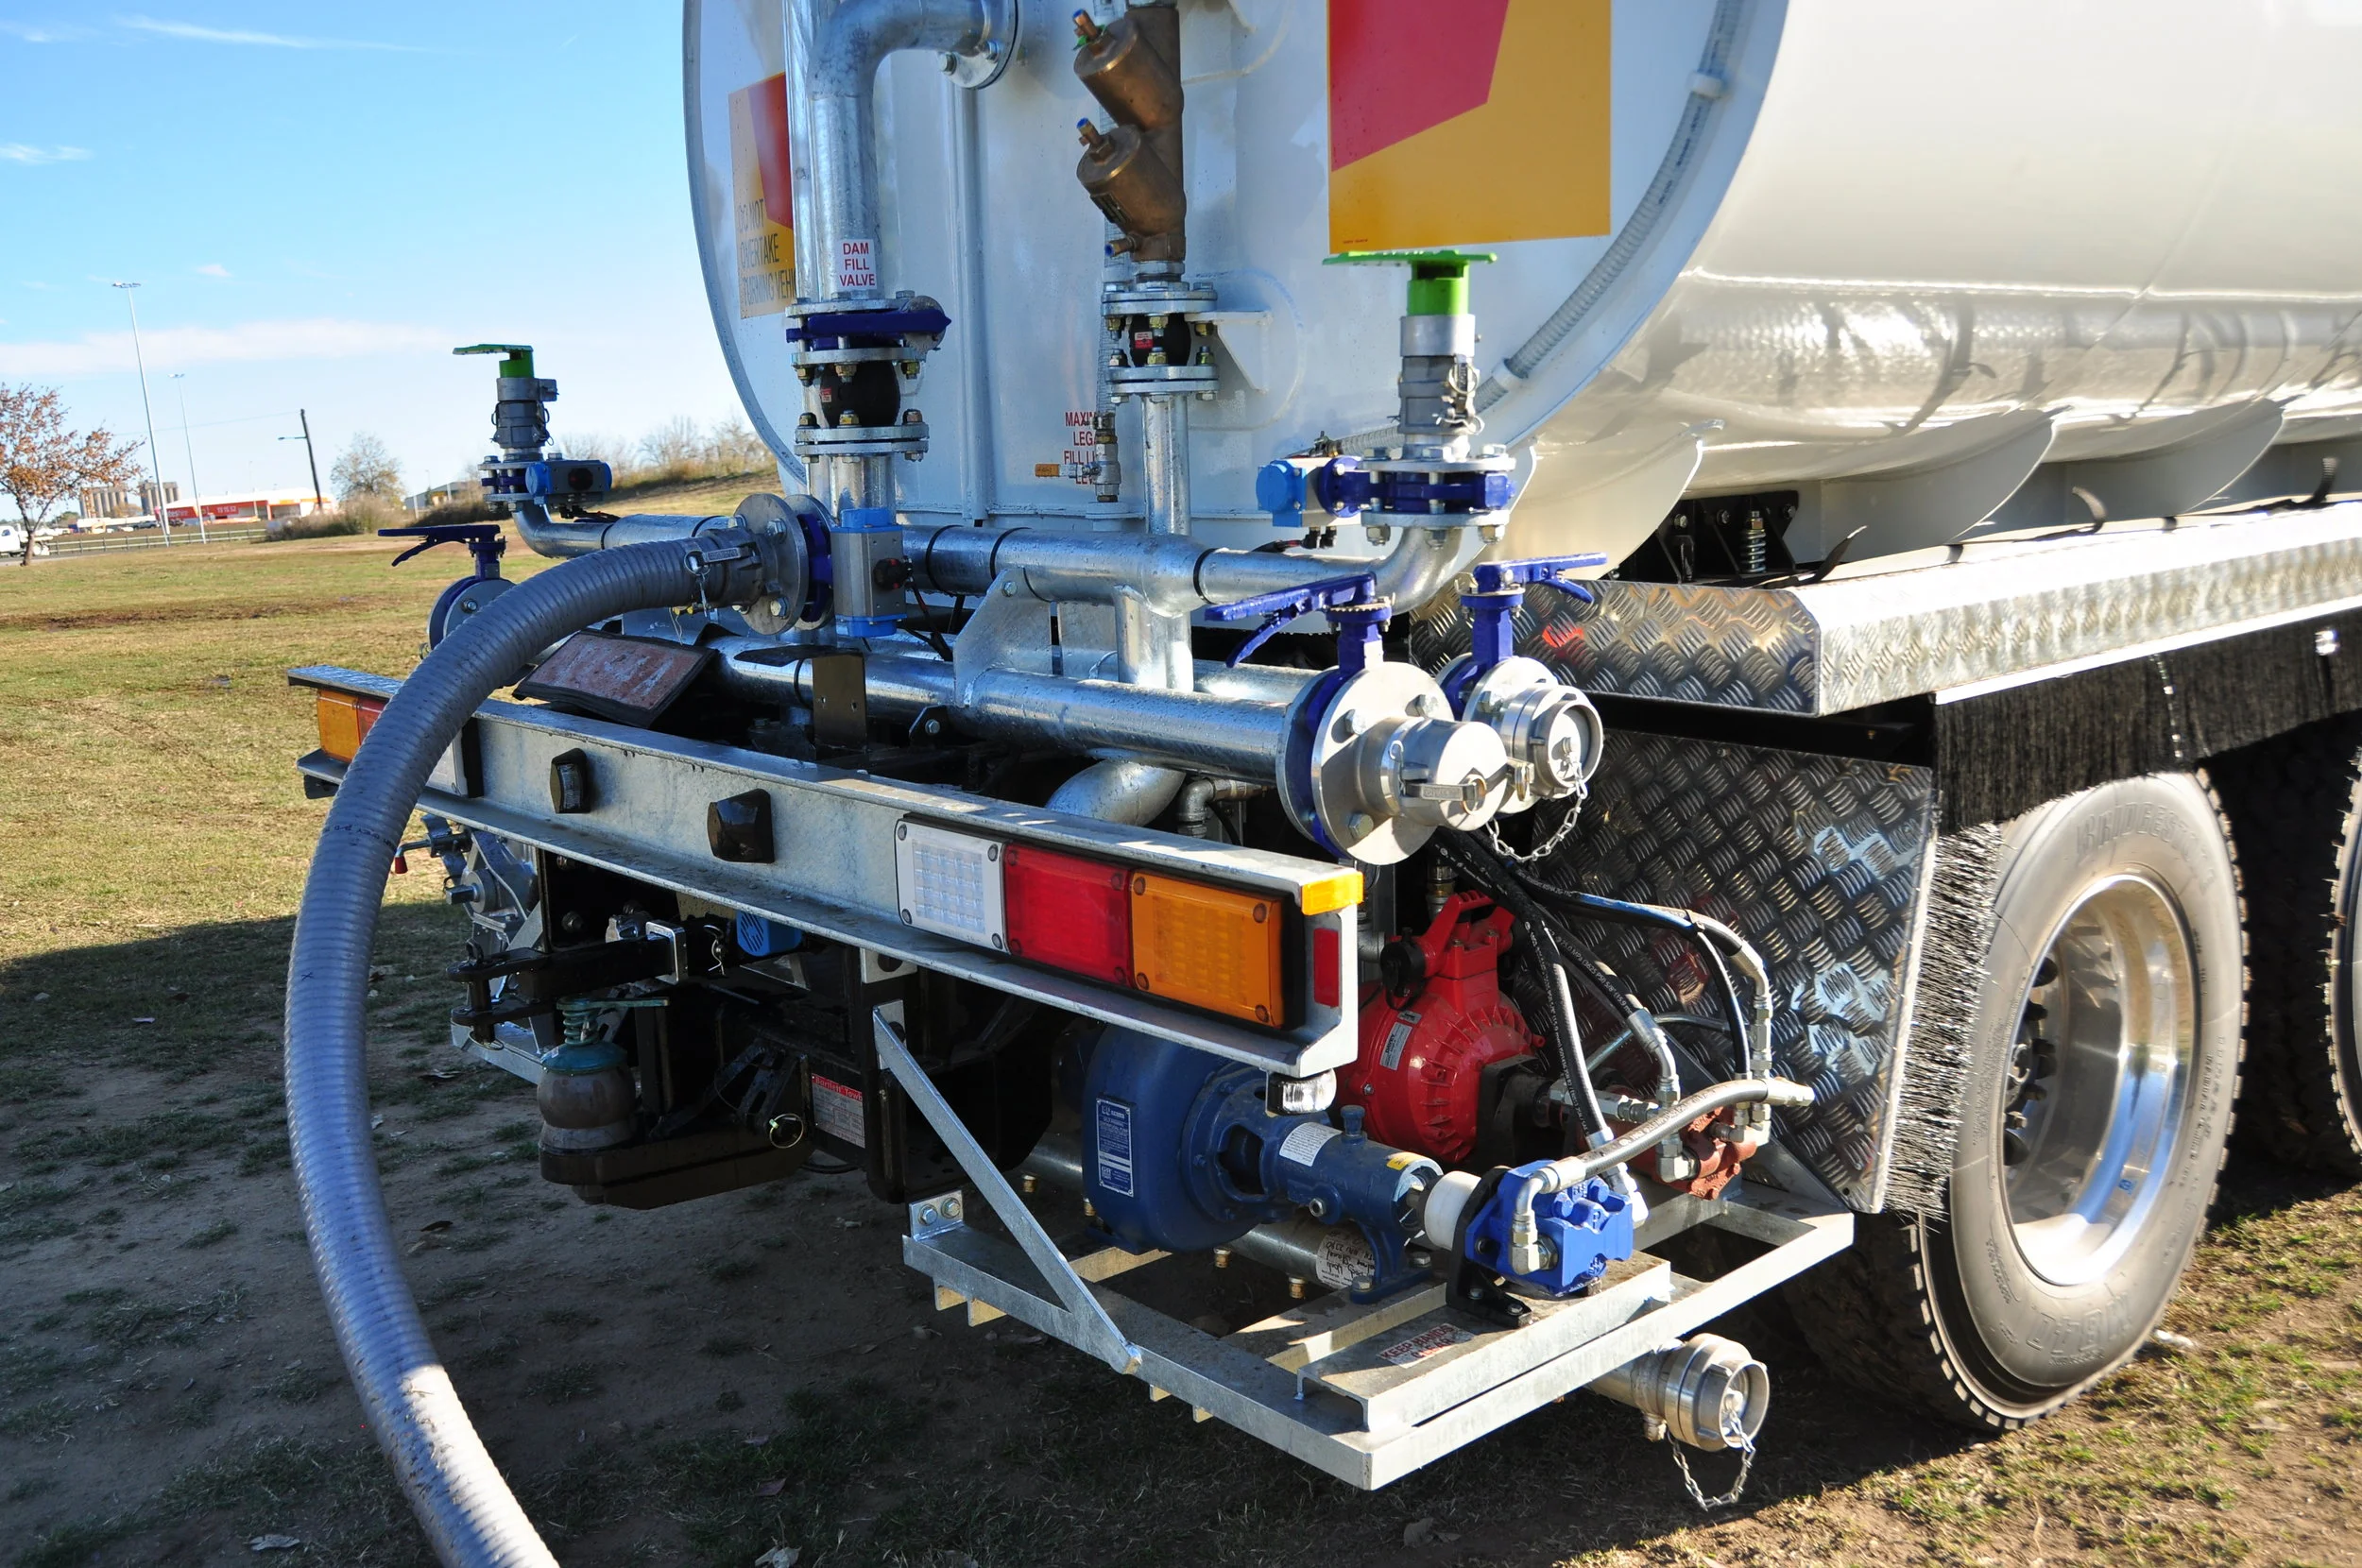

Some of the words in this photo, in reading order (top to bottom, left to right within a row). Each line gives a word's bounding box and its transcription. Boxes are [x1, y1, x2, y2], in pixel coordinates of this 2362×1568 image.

[749, 198, 764, 229] NOT
[740, 233, 780, 269] OVERTAKE
[843, 242, 869, 255] DAM
[845, 258, 870, 271] FILL
[744, 270, 775, 307] TURNING
[775, 267, 796, 300] VEHI
[839, 273, 876, 287] VALVE
[1073, 431, 1096, 446] LEG
[1064, 451, 1084, 465] FILL
[1380, 1341, 1413, 1358] KEEP
[1412, 1323, 1454, 1346] HANDS
[1410, 1338, 1455, 1358] CLEAR
